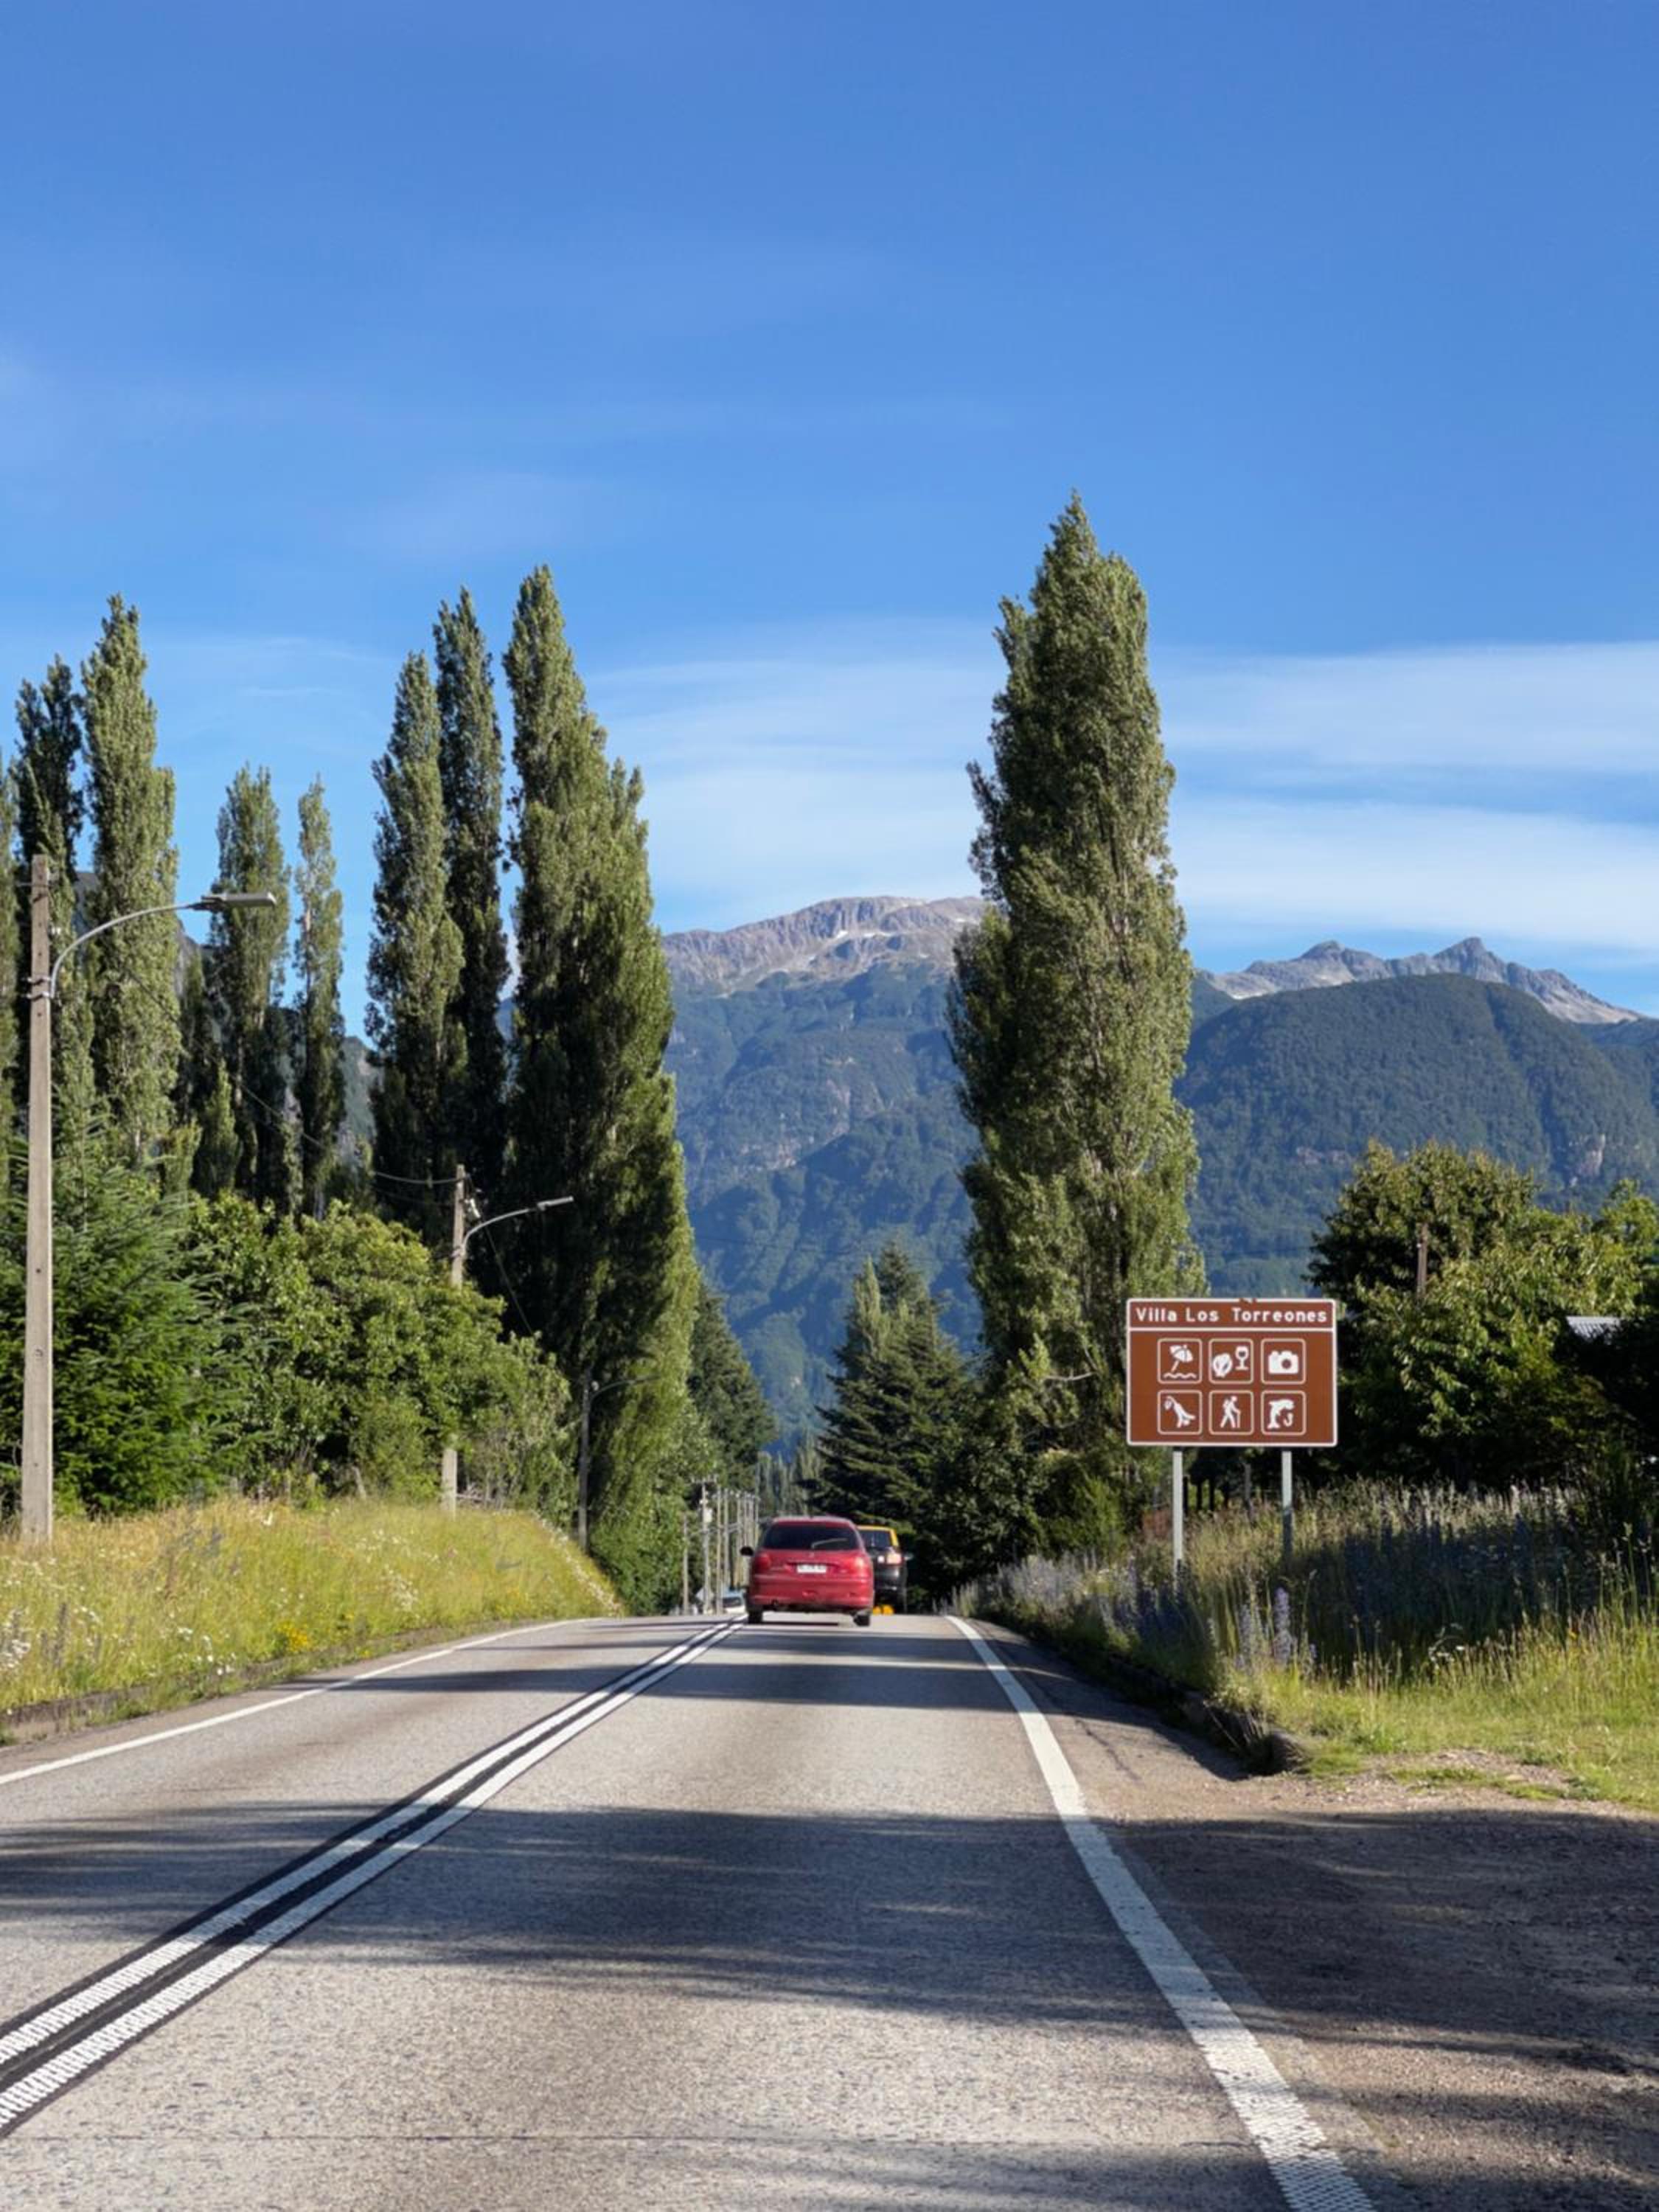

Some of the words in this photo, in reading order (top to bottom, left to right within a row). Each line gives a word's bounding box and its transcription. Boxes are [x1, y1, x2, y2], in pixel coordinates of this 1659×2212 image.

[1135, 1307, 1178, 1322] Villa
[1186, 1307, 1220, 1322] Los
[1231, 1307, 1327, 1322] Torreones
